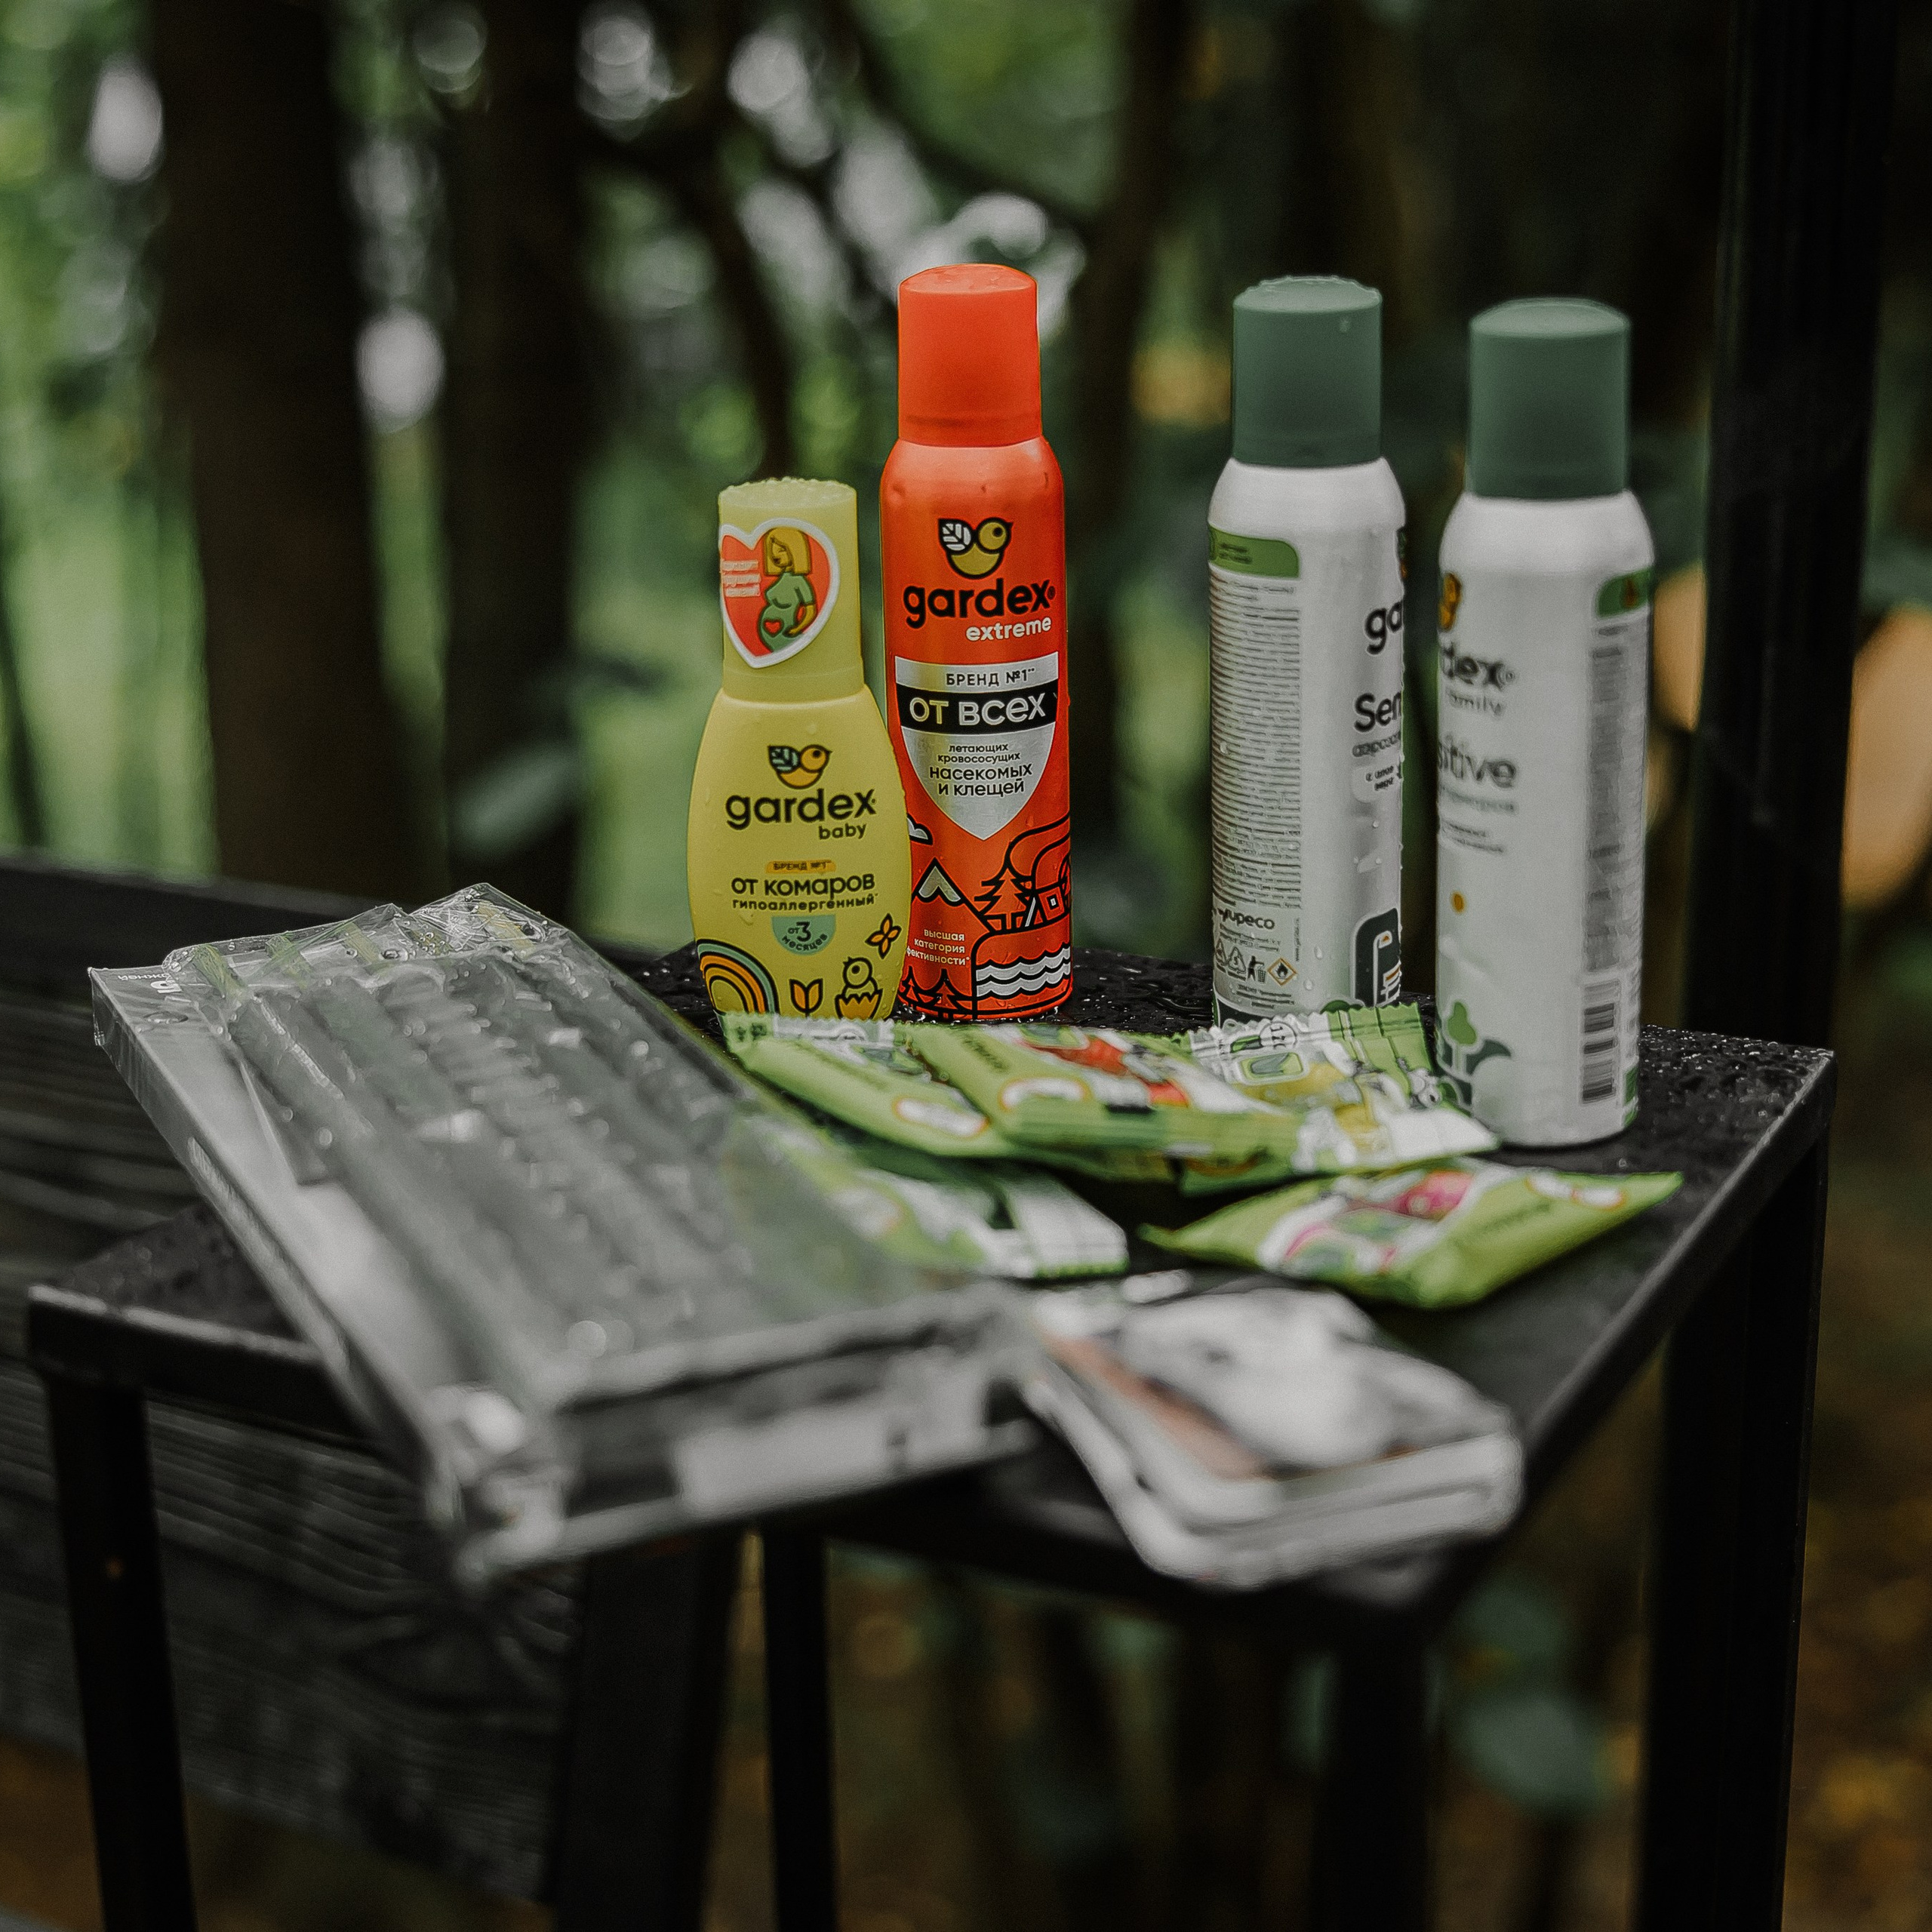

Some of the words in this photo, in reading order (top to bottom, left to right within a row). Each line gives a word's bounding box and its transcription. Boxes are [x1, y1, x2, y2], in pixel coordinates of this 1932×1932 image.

[903, 578, 1052, 629] gardex
[966, 617, 1052, 641] extreme
[946, 672, 999, 686] БРЕНД
[949, 743, 1008, 753] летающих
[937, 752, 1020, 764] кровососущих
[929, 764, 1032, 780] насекомых
[938, 783, 949, 795] и
[954, 778, 1024, 797] клещей
[725, 788, 877, 830] gardex
[818, 823, 866, 840] baby
[731, 878, 758, 894] от
[764, 873, 875, 900] комаров
[796, 921, 811, 942] 3
[924, 929, 964, 941] высшая
[914, 938, 965, 954] категория
[906, 946, 970, 965] фективности
